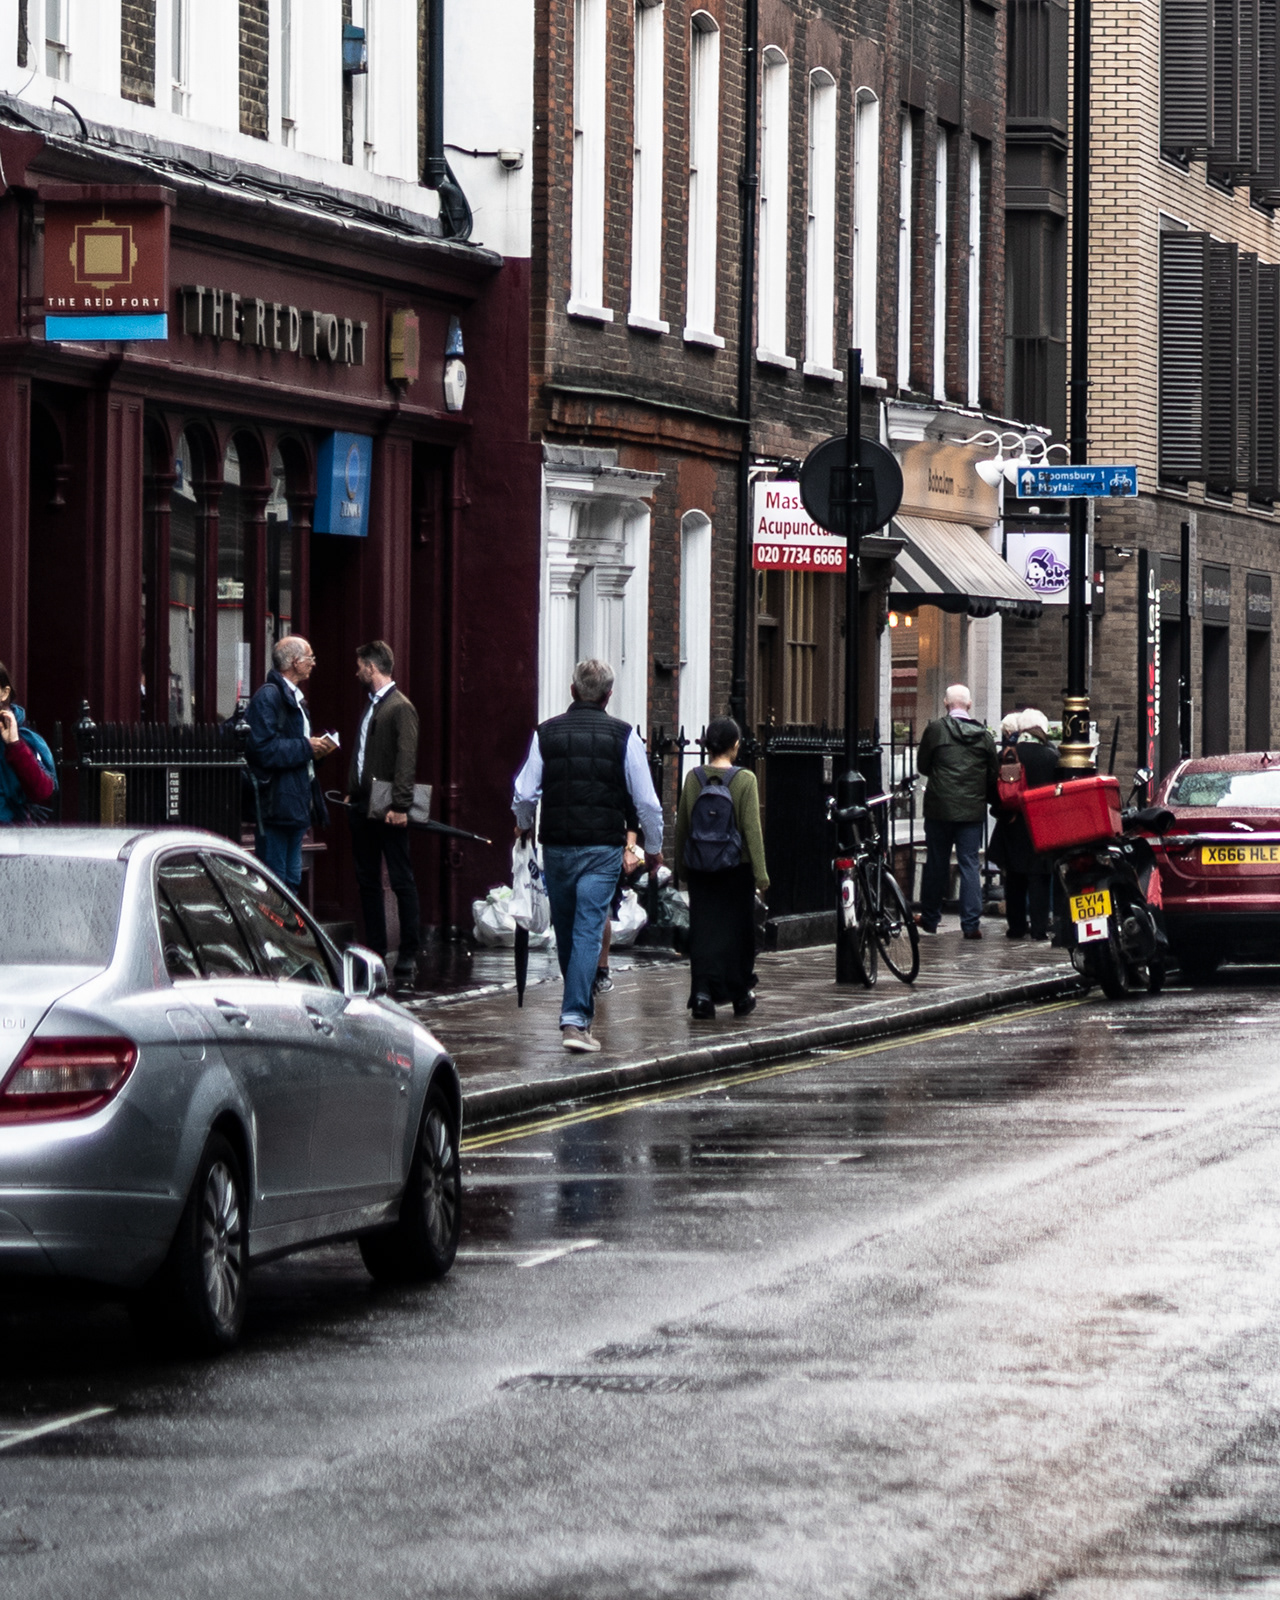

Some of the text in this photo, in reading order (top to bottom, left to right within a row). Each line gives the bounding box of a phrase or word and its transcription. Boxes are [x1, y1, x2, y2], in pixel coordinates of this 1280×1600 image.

[48, 298, 160, 307] THE RED FORT
[190, 284, 369, 367] THE RED FORT
[1101, 470, 1105, 479] 1
[757, 546, 843, 565] 020 7734 6666
[1208, 848, 1246, 862] X666
[1250, 847, 1279, 861] HLE
[1075, 894, 1105, 909] EY14
[1086, 923, 1101, 938] L
